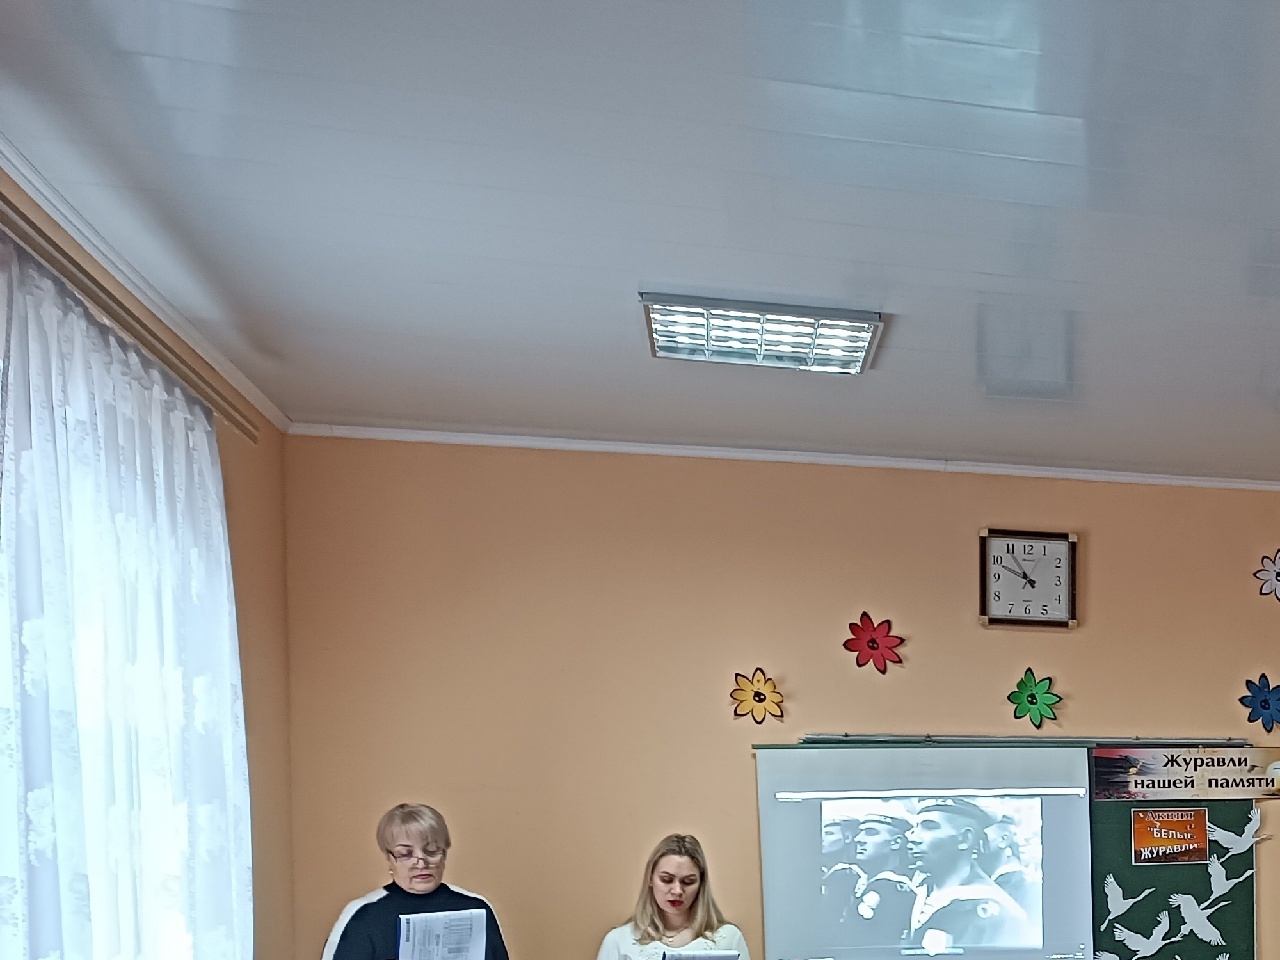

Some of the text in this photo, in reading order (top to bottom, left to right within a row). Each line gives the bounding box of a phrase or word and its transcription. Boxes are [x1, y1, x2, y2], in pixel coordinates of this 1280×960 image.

[1006, 543, 1015, 554] 11
[1023, 544, 1034, 555] 12
[1042, 545, 1047, 556] 1
[992, 555, 1003, 566] 10
[1054, 557, 1062, 569] 2
[993, 572, 1001, 583] 9
[1054, 575, 1062, 587] 3
[993, 590, 1001, 602] 8
[1054, 594, 1061, 604] 4
[1008, 603, 1014, 614] 7
[1024, 604, 1031, 615] 6
[1040, 604, 1048, 616] 5
[1162, 754, 1248, 772] Журавли
[1134, 775, 1275, 788] нашей памяти
